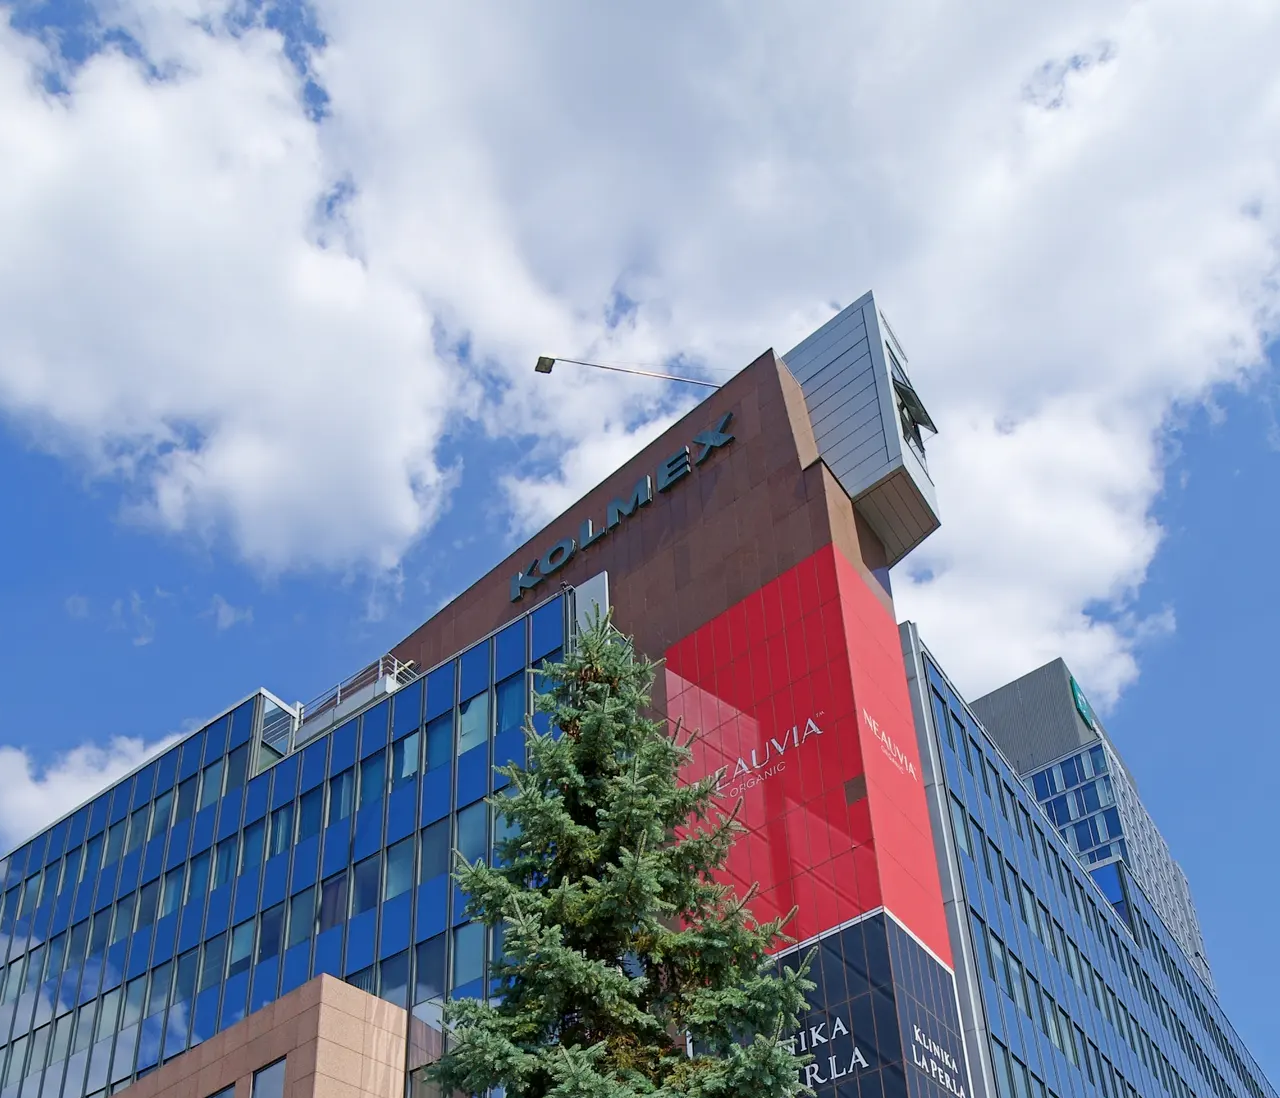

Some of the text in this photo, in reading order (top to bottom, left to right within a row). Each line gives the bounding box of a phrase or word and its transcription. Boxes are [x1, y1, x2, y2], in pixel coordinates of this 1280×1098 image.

[511, 411, 736, 603] KOLMEX
[863, 708, 918, 782] NEAUVIA
[729, 761, 787, 798] ORGANIC
[782, 1017, 849, 1056] NIKA
[911, 1044, 930, 1073] LA
[913, 1024, 959, 1074] KLINIKA
